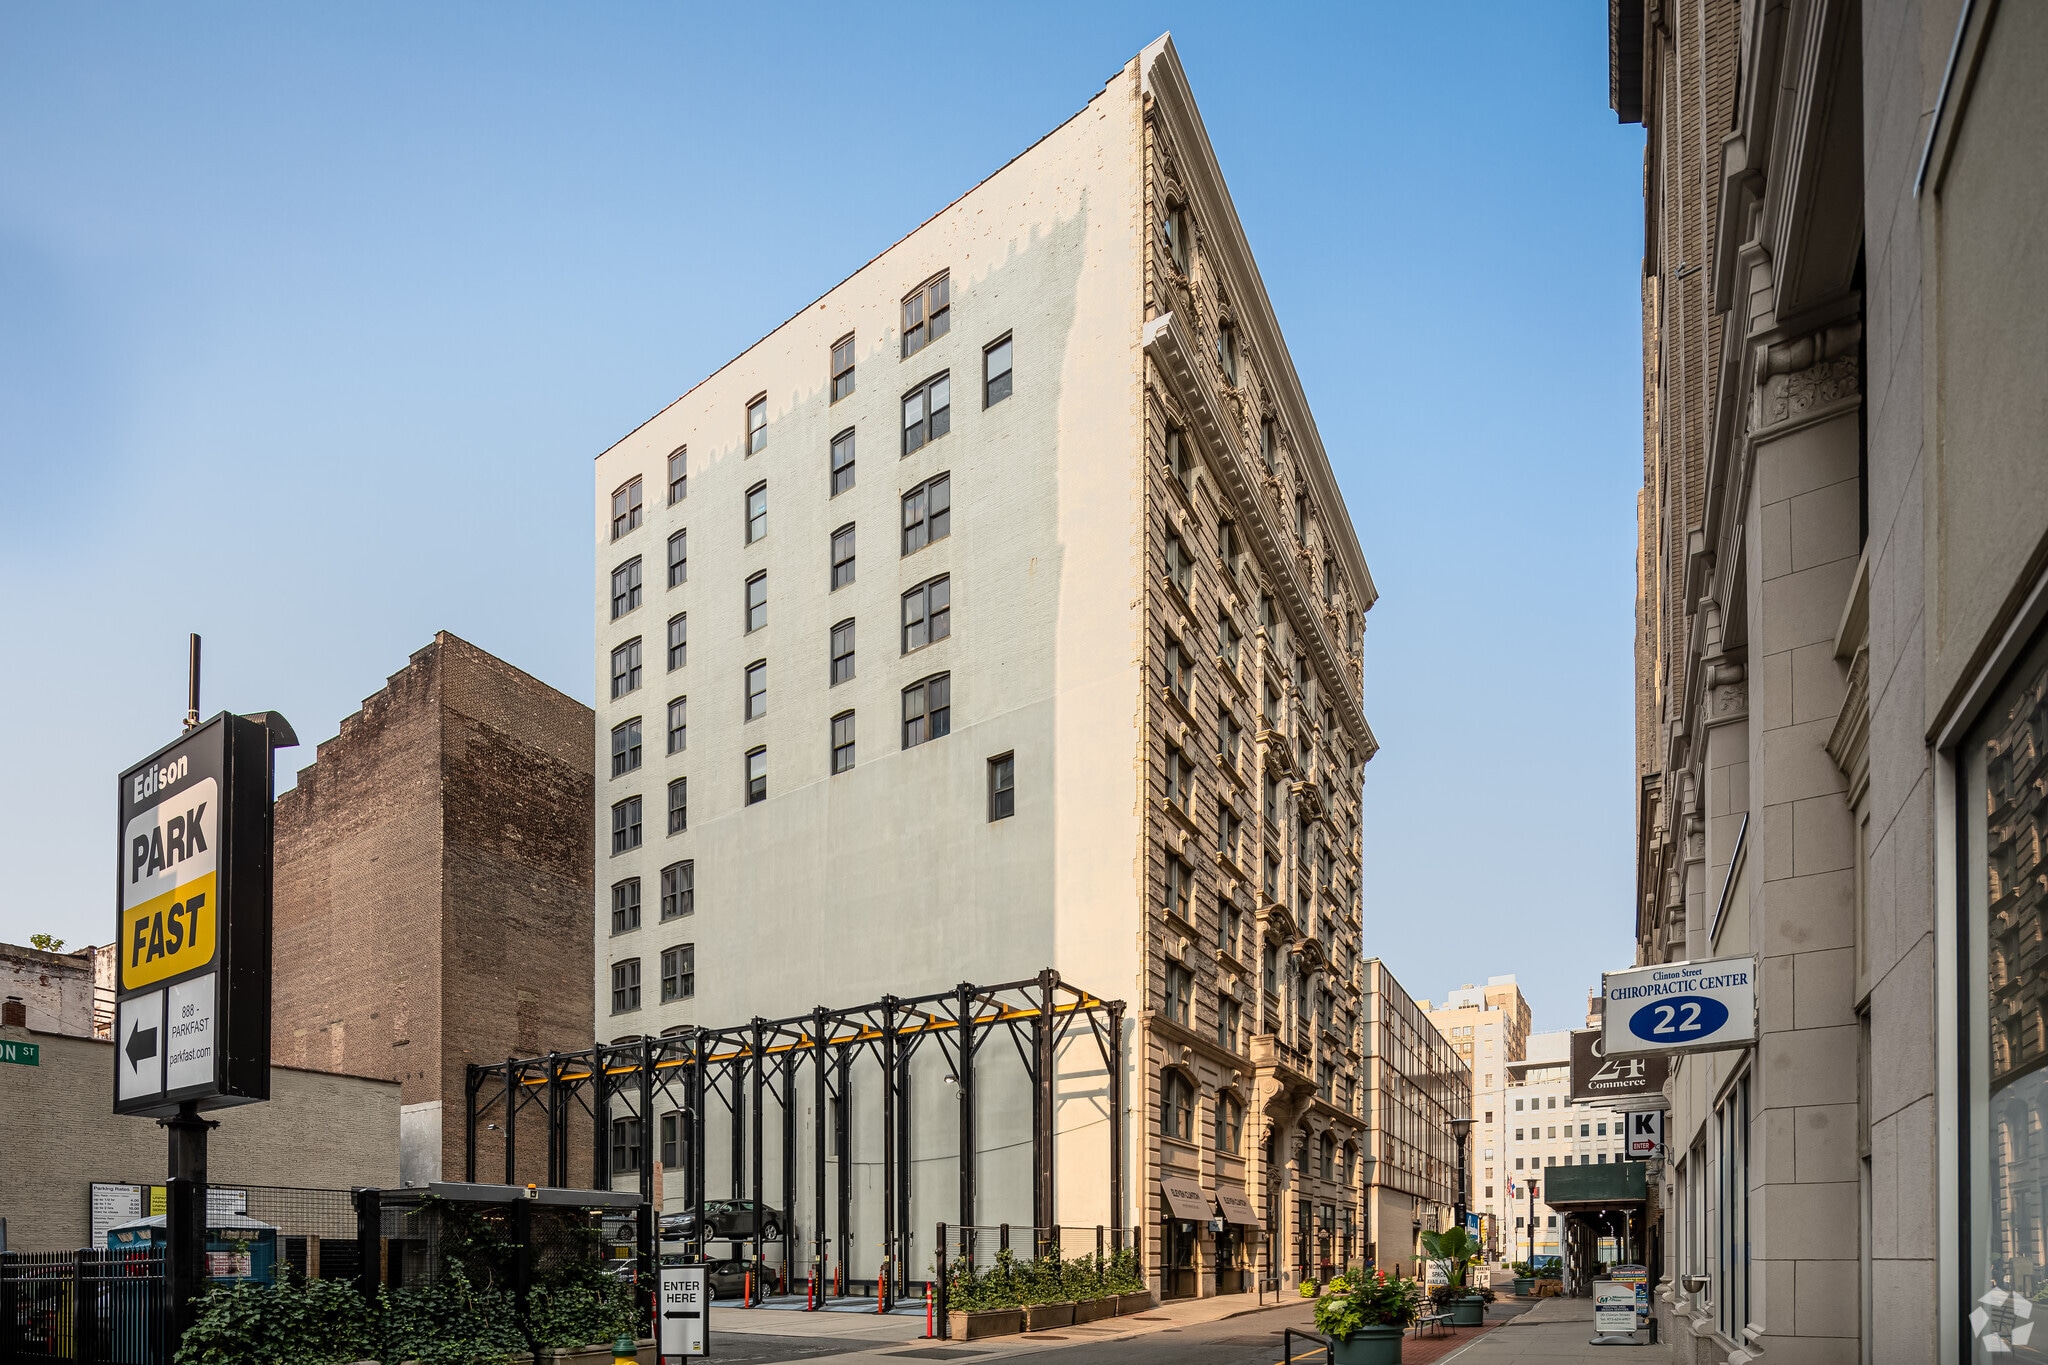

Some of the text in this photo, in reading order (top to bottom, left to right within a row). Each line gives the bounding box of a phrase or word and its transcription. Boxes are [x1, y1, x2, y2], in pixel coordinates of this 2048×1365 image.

[134, 755, 188, 804] Edison
[132, 801, 208, 885] PARK
[132, 893, 206, 968] FAST
[1653, 968, 1702, 981] Clinton Street
[1610, 972, 1749, 1001] CHIROPRACTIC CENTER
[181, 1003, 195, 1019] 888
[1653, 1002, 1702, 1035] 22
[172, 1017, 210, 1039] PARKFAST
[23, 1046, 35, 1056] ST
[169, 1046, 211, 1067] parkfast.com
[1588, 1079, 1646, 1090] Commerce
[1635, 1113, 1656, 1135] K
[1633, 1142, 1650, 1150] ENTER
[663, 1281, 700, 1291] ENTER
[666, 1293, 697, 1303] HERE
